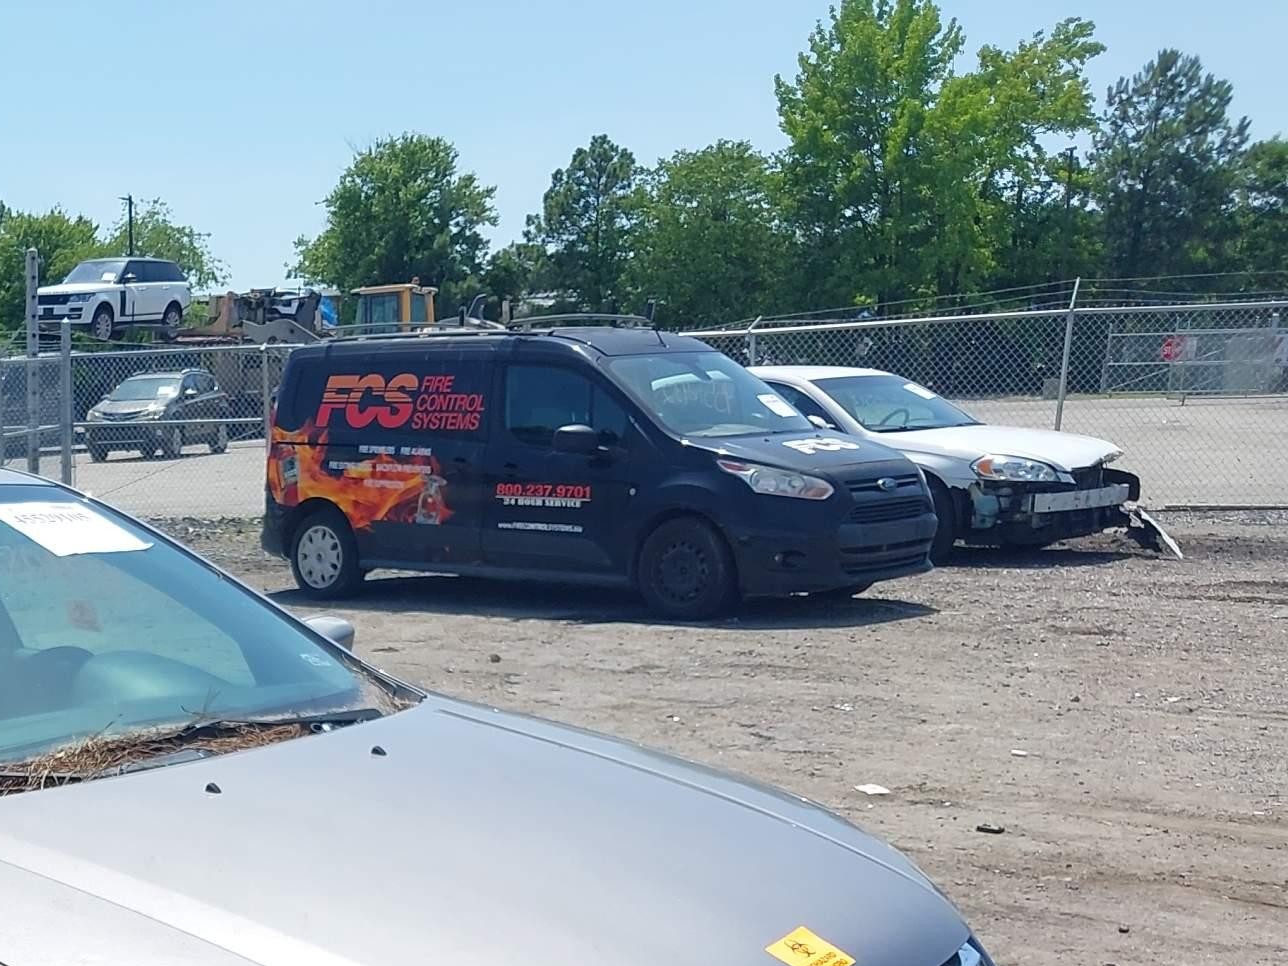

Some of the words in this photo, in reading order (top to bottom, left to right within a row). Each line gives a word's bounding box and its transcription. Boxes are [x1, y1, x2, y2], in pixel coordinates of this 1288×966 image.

[421, 375, 455, 393] FIRE
[316, 373, 419, 429] FCS
[416, 394, 485, 411] CONTROL
[412, 412, 480, 430] SYSTEMS
[496, 483, 591, 498] 800.237.9701
[544, 498, 581, 508] SERVICE
